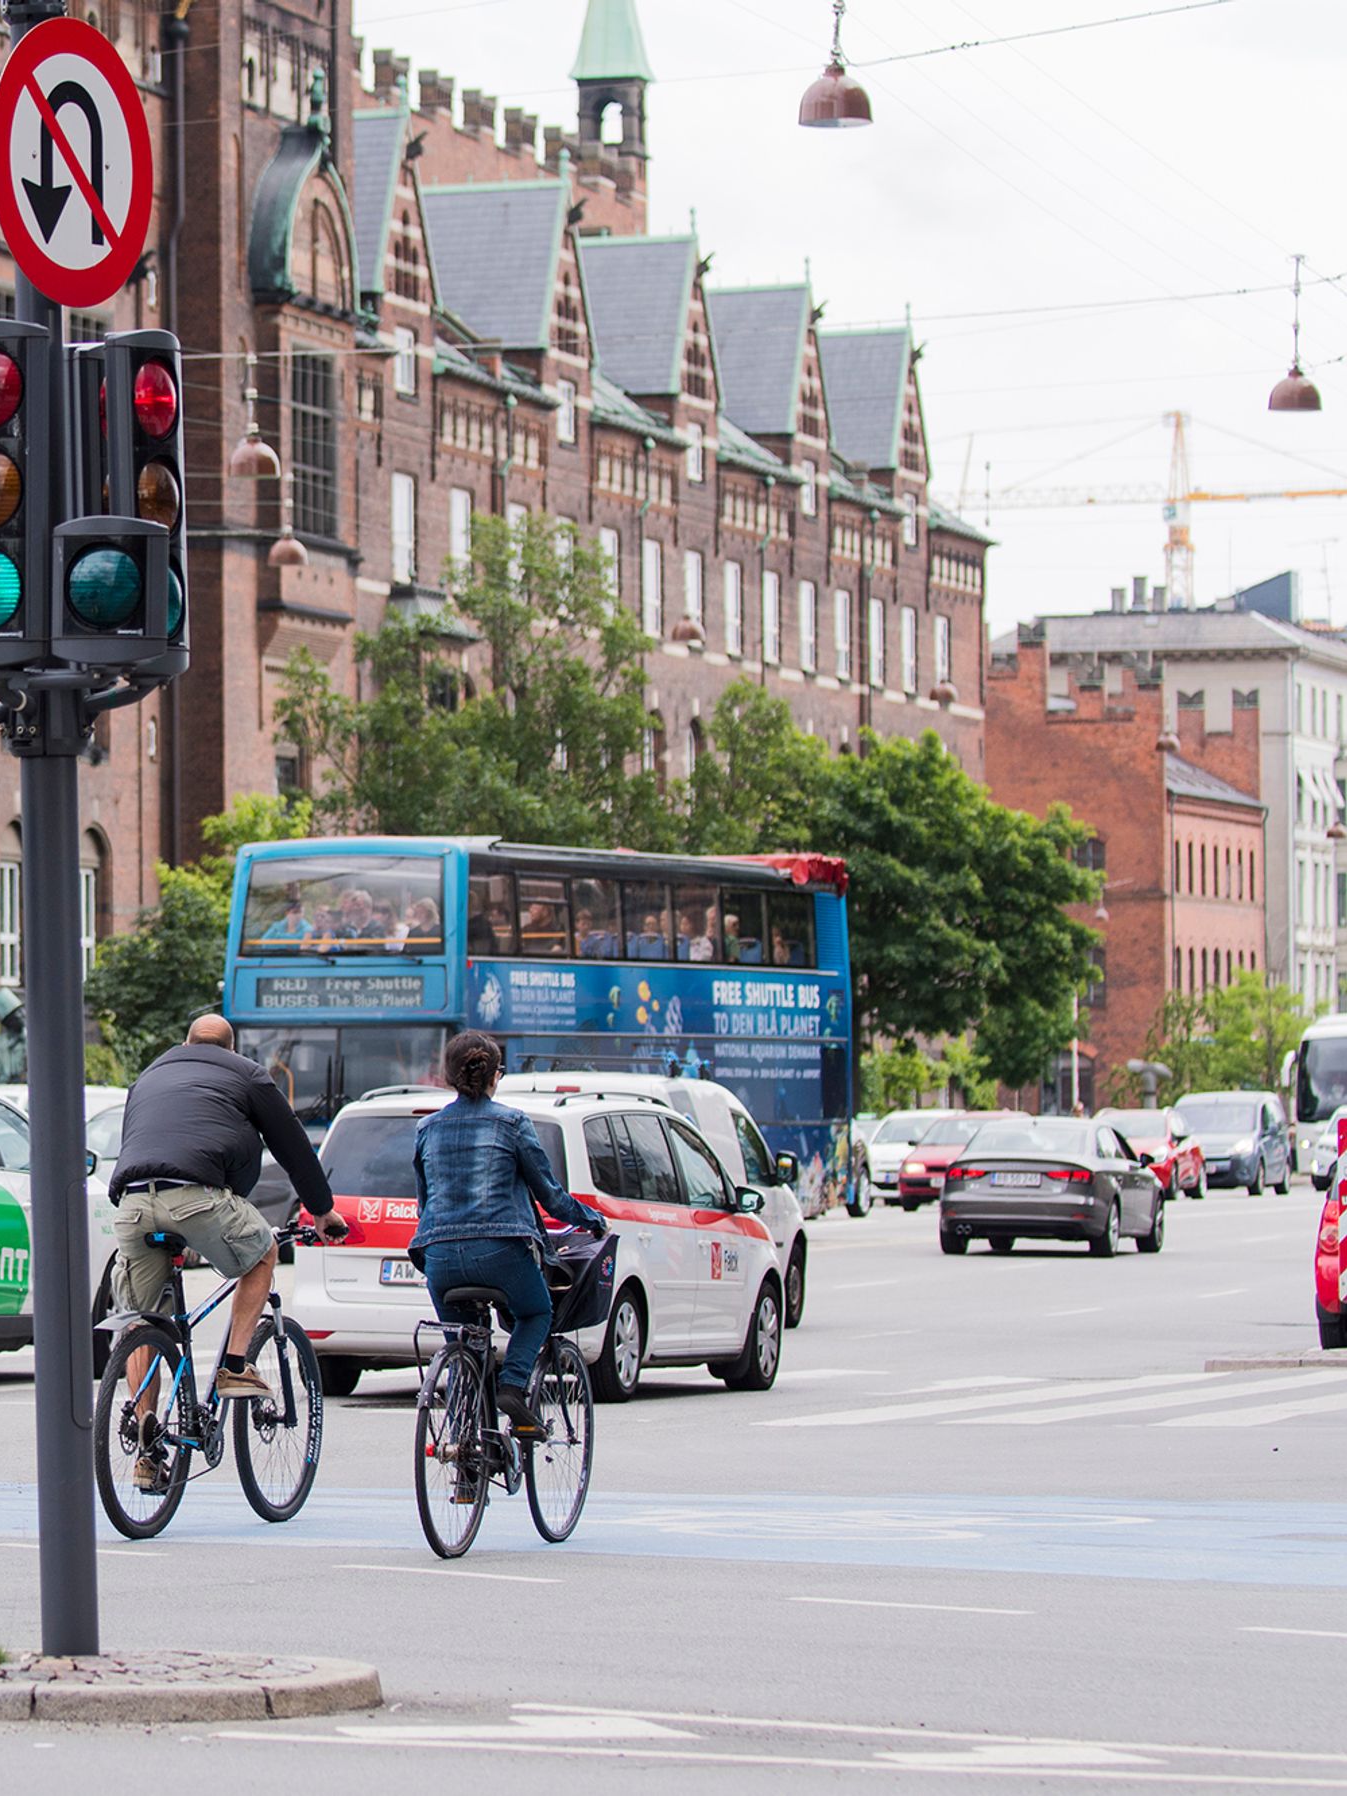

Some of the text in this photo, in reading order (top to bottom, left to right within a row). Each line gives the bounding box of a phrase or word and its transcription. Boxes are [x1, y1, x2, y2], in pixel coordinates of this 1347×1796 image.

[272, 978, 308, 991] RED
[325, 977, 421, 991] Free Shuttle
[510, 971, 528, 986] FREE
[561, 973, 575, 988] BUS
[261, 994, 319, 1008] BUSES
[327, 994, 421, 1007] The Blue Planet
[713, 980, 820, 1009] FREE SHUTTLE BUS
[714, 1008, 821, 1037] TO DEN BLÅ PLANET
[714, 1043, 750, 1058] NATIONAL
[788, 1045, 821, 1060] DENMARK
